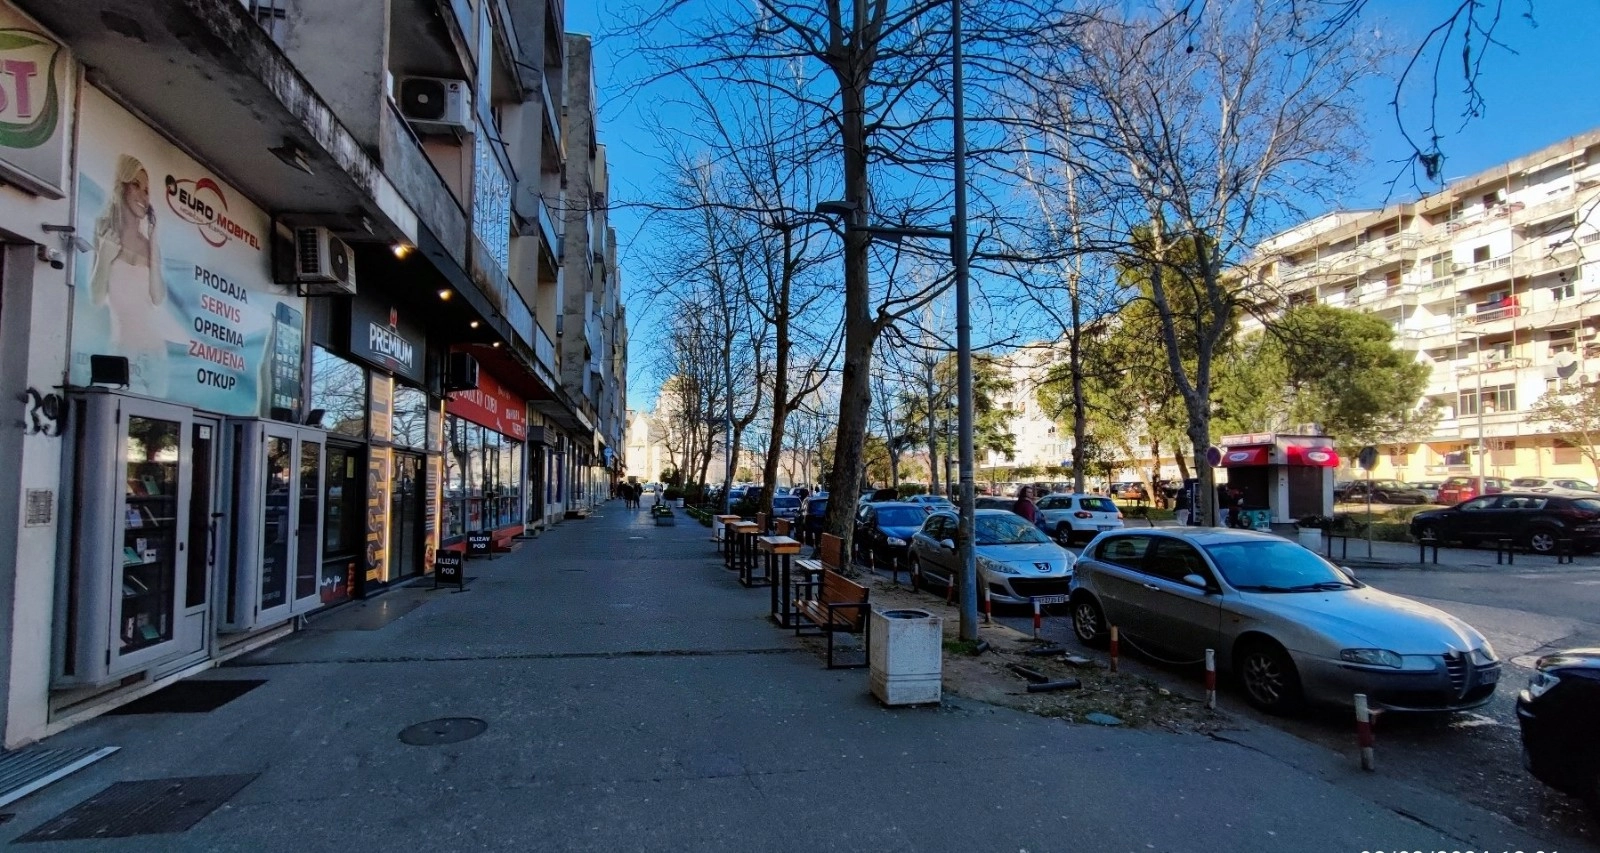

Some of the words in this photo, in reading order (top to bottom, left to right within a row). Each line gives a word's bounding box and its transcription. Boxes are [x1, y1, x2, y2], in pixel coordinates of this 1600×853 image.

[178, 188, 214, 221] EURO
[216, 212, 261, 251] MOBITEL
[194, 264, 248, 304] PRODAJA
[201, 293, 241, 323] SERVIS
[194, 316, 244, 348] OPREMA
[369, 322, 413, 369] PREMIUM
[188, 339, 245, 371] ZAMJENA
[196, 367, 236, 391] OTKUP
[22, 386, 68, 438] 39
[437, 557, 460, 566] KLIZAV
[441, 567, 455, 575] POD
